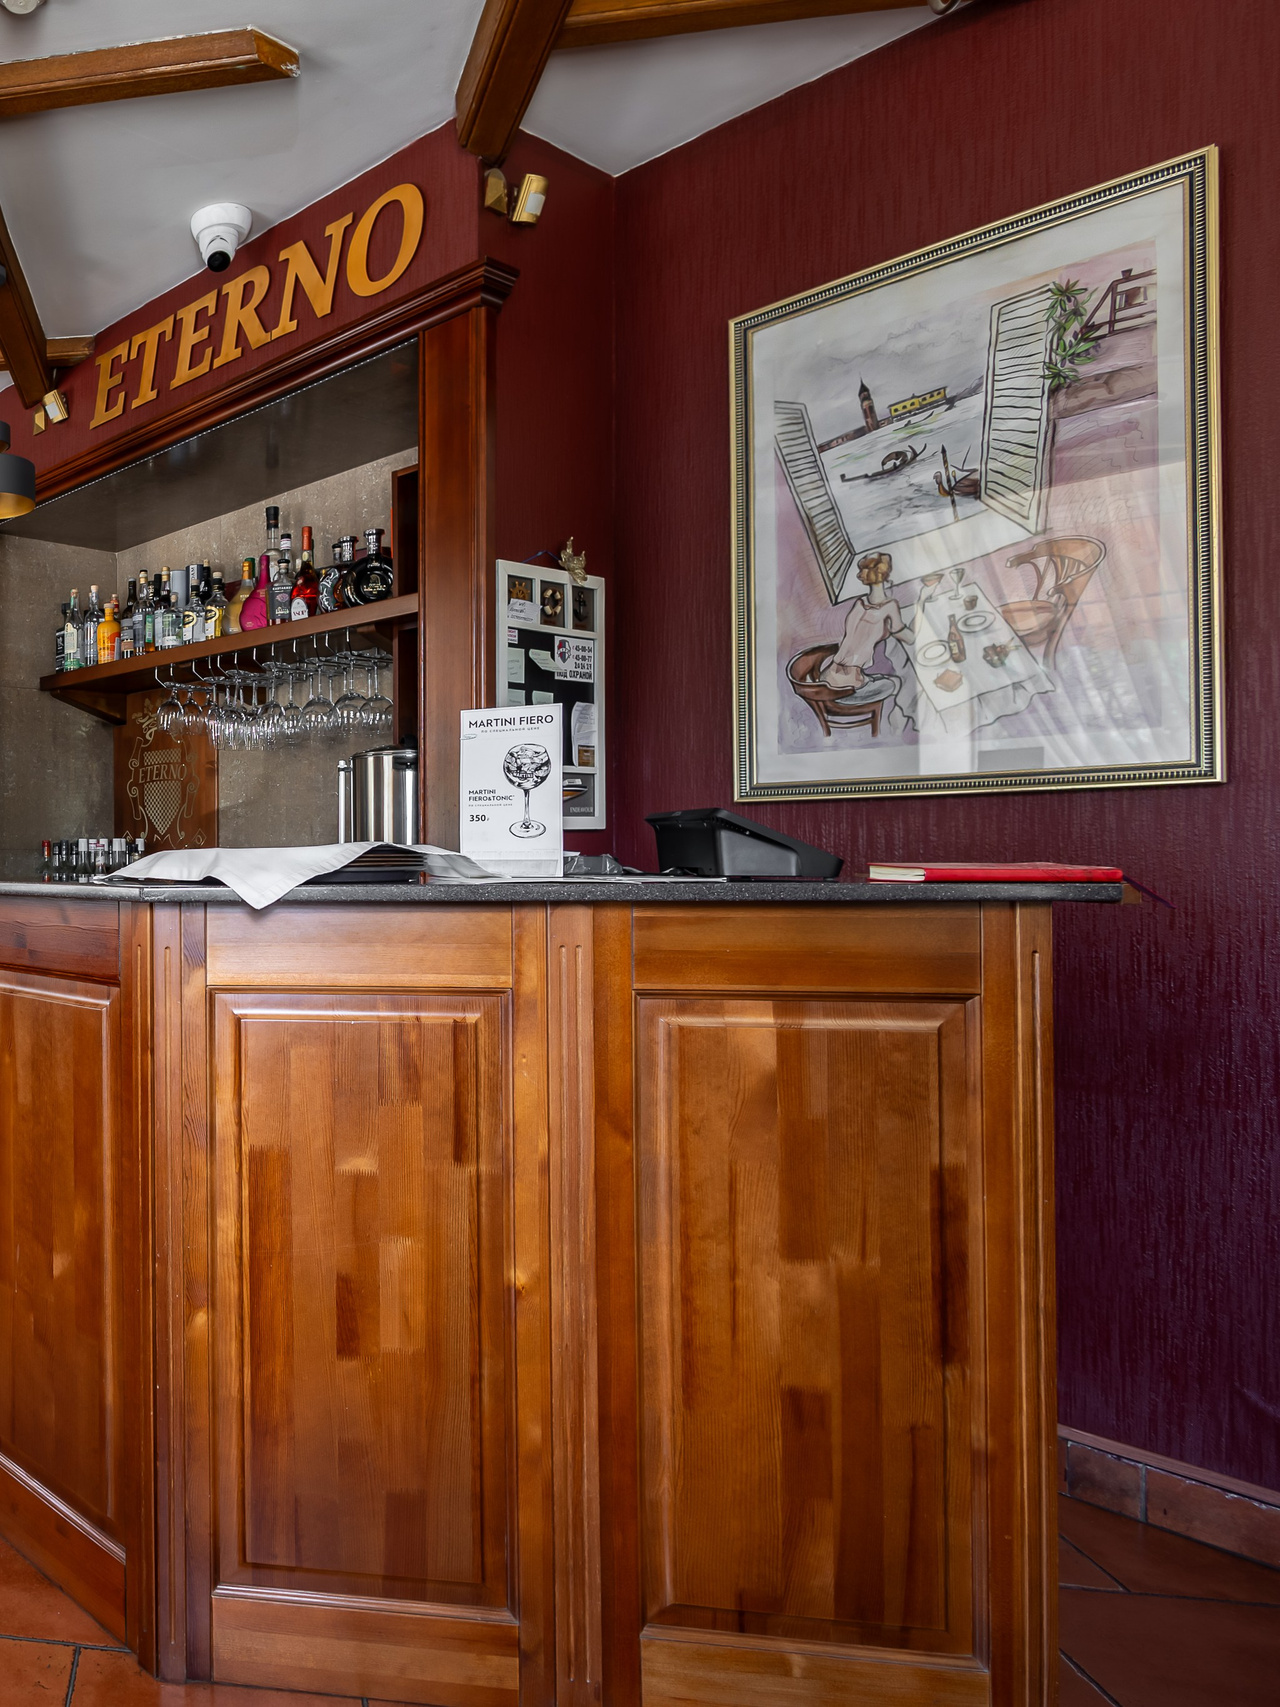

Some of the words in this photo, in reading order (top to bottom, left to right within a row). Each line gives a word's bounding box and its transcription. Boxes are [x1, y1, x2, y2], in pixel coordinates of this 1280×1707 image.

[88, 182, 425, 430] ETERNO
[569, 670, 593, 680] ОХРАНОЙ
[468, 717, 516, 728] MARTINI
[519, 714, 554, 726] FIERO
[138, 763, 188, 784] ETERNO
